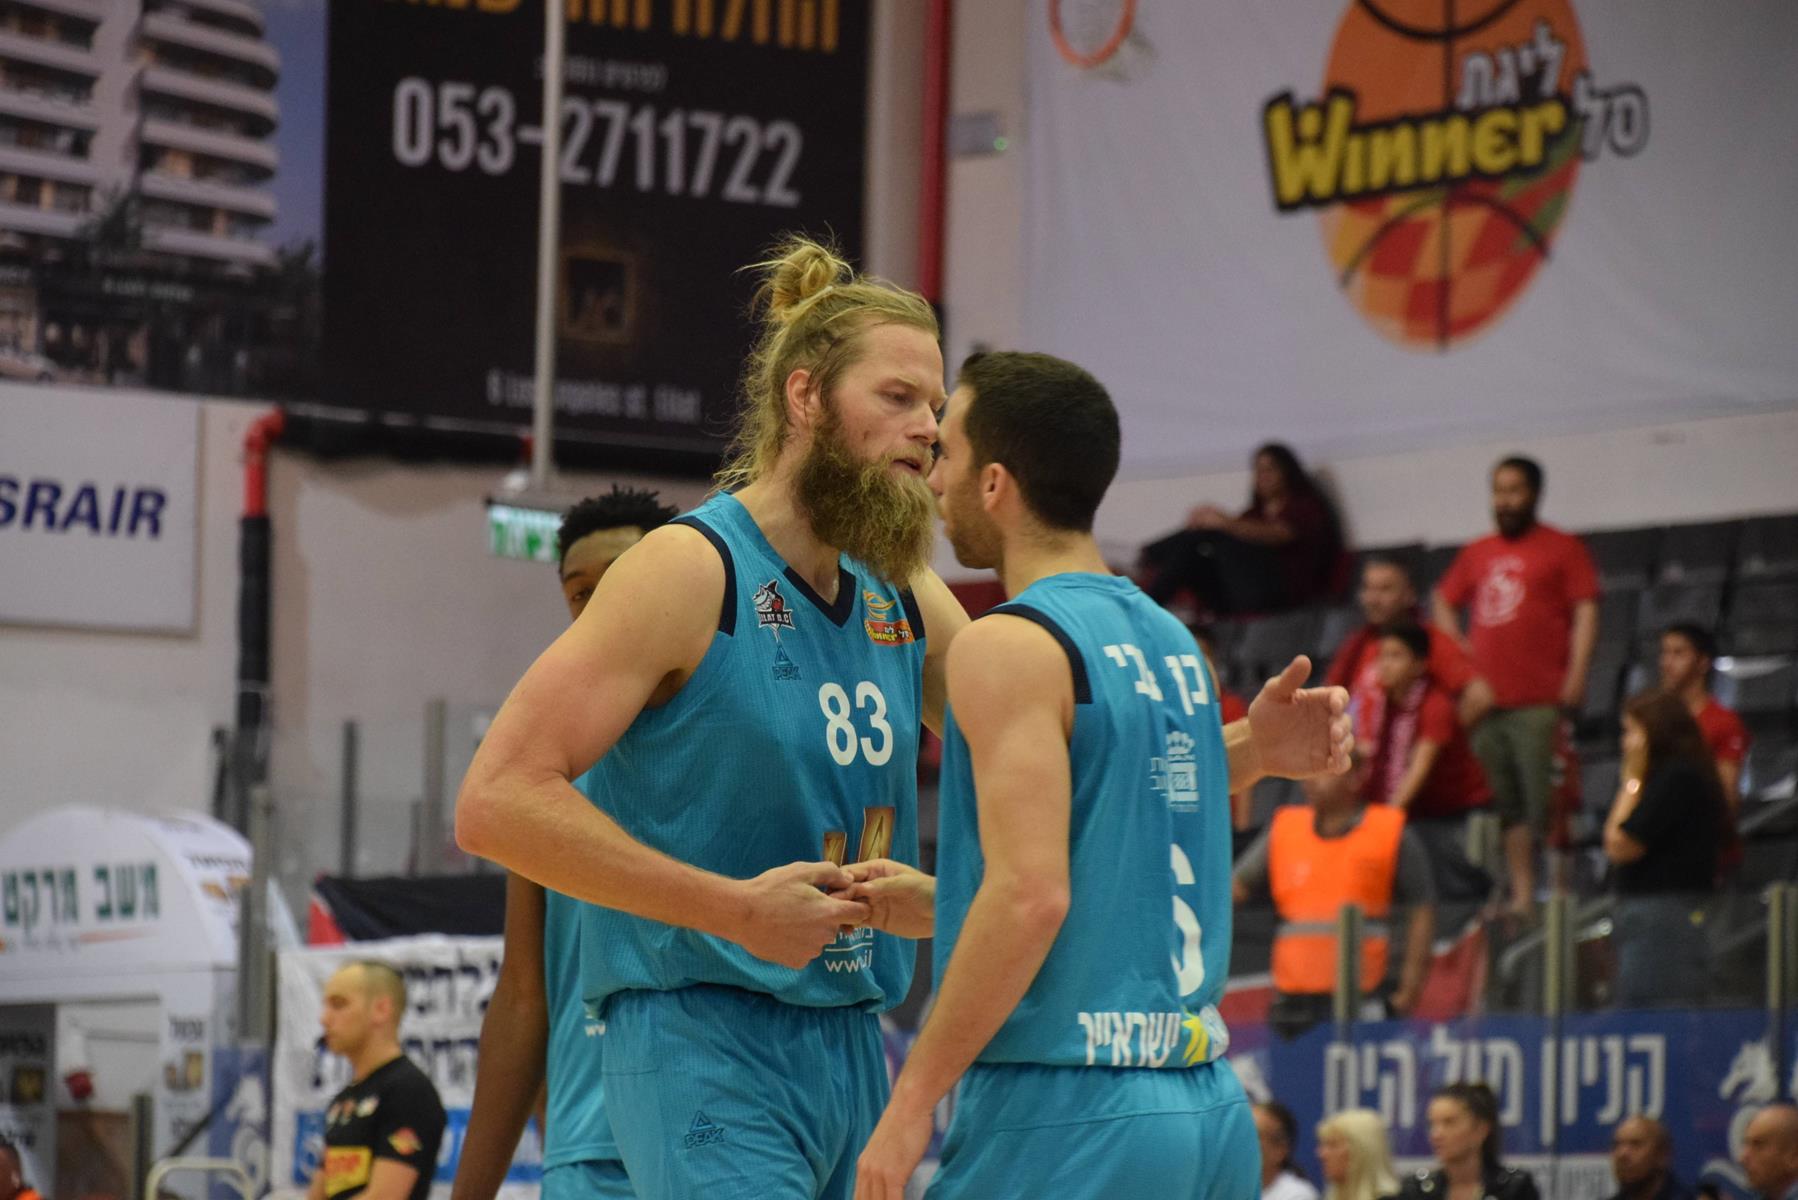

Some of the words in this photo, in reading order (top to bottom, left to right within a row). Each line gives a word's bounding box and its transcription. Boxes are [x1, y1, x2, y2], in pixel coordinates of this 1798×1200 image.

[1265, 96, 1566, 208] Winner
[818, 681, 893, 766] 83
[1163, 654, 1209, 716] בן
